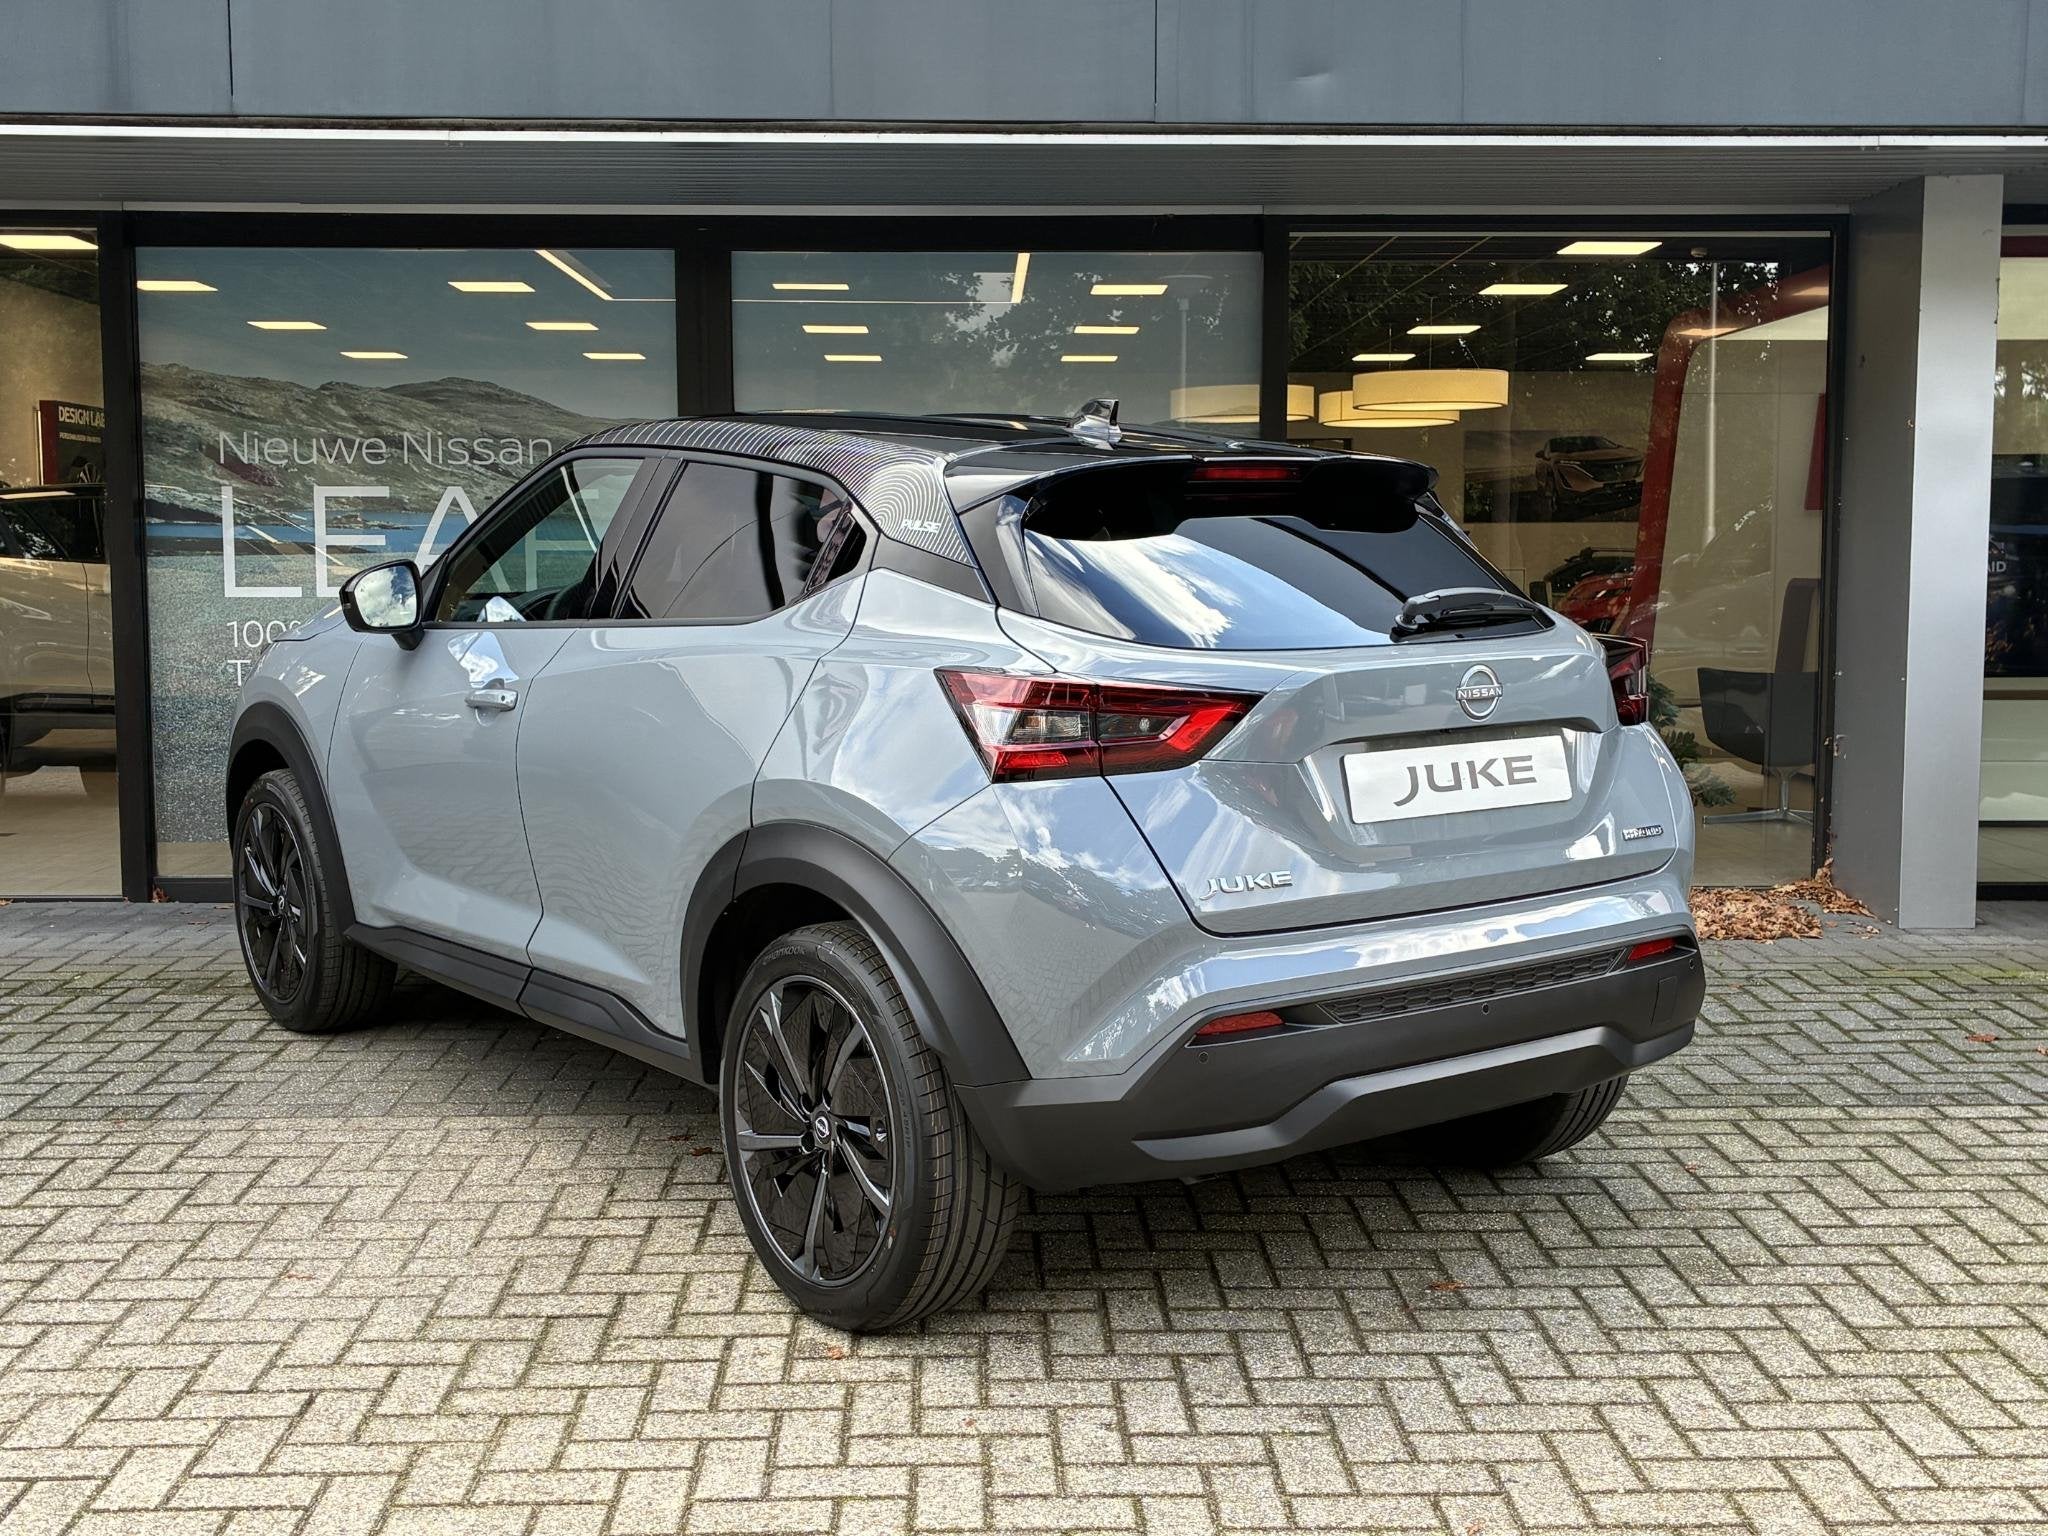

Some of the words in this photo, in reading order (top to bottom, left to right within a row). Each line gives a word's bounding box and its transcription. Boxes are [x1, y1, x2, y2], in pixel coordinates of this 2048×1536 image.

[58, 405, 90, 425] DESIGN
[218, 431, 388, 465] Nieuwe
[403, 431, 553, 465] Nissan
[226, 620, 301, 648] 100
[1457, 686, 1502, 699] NISSAN
[1393, 754, 1537, 807] JUKE
[1199, 870, 1293, 901] JUKE
